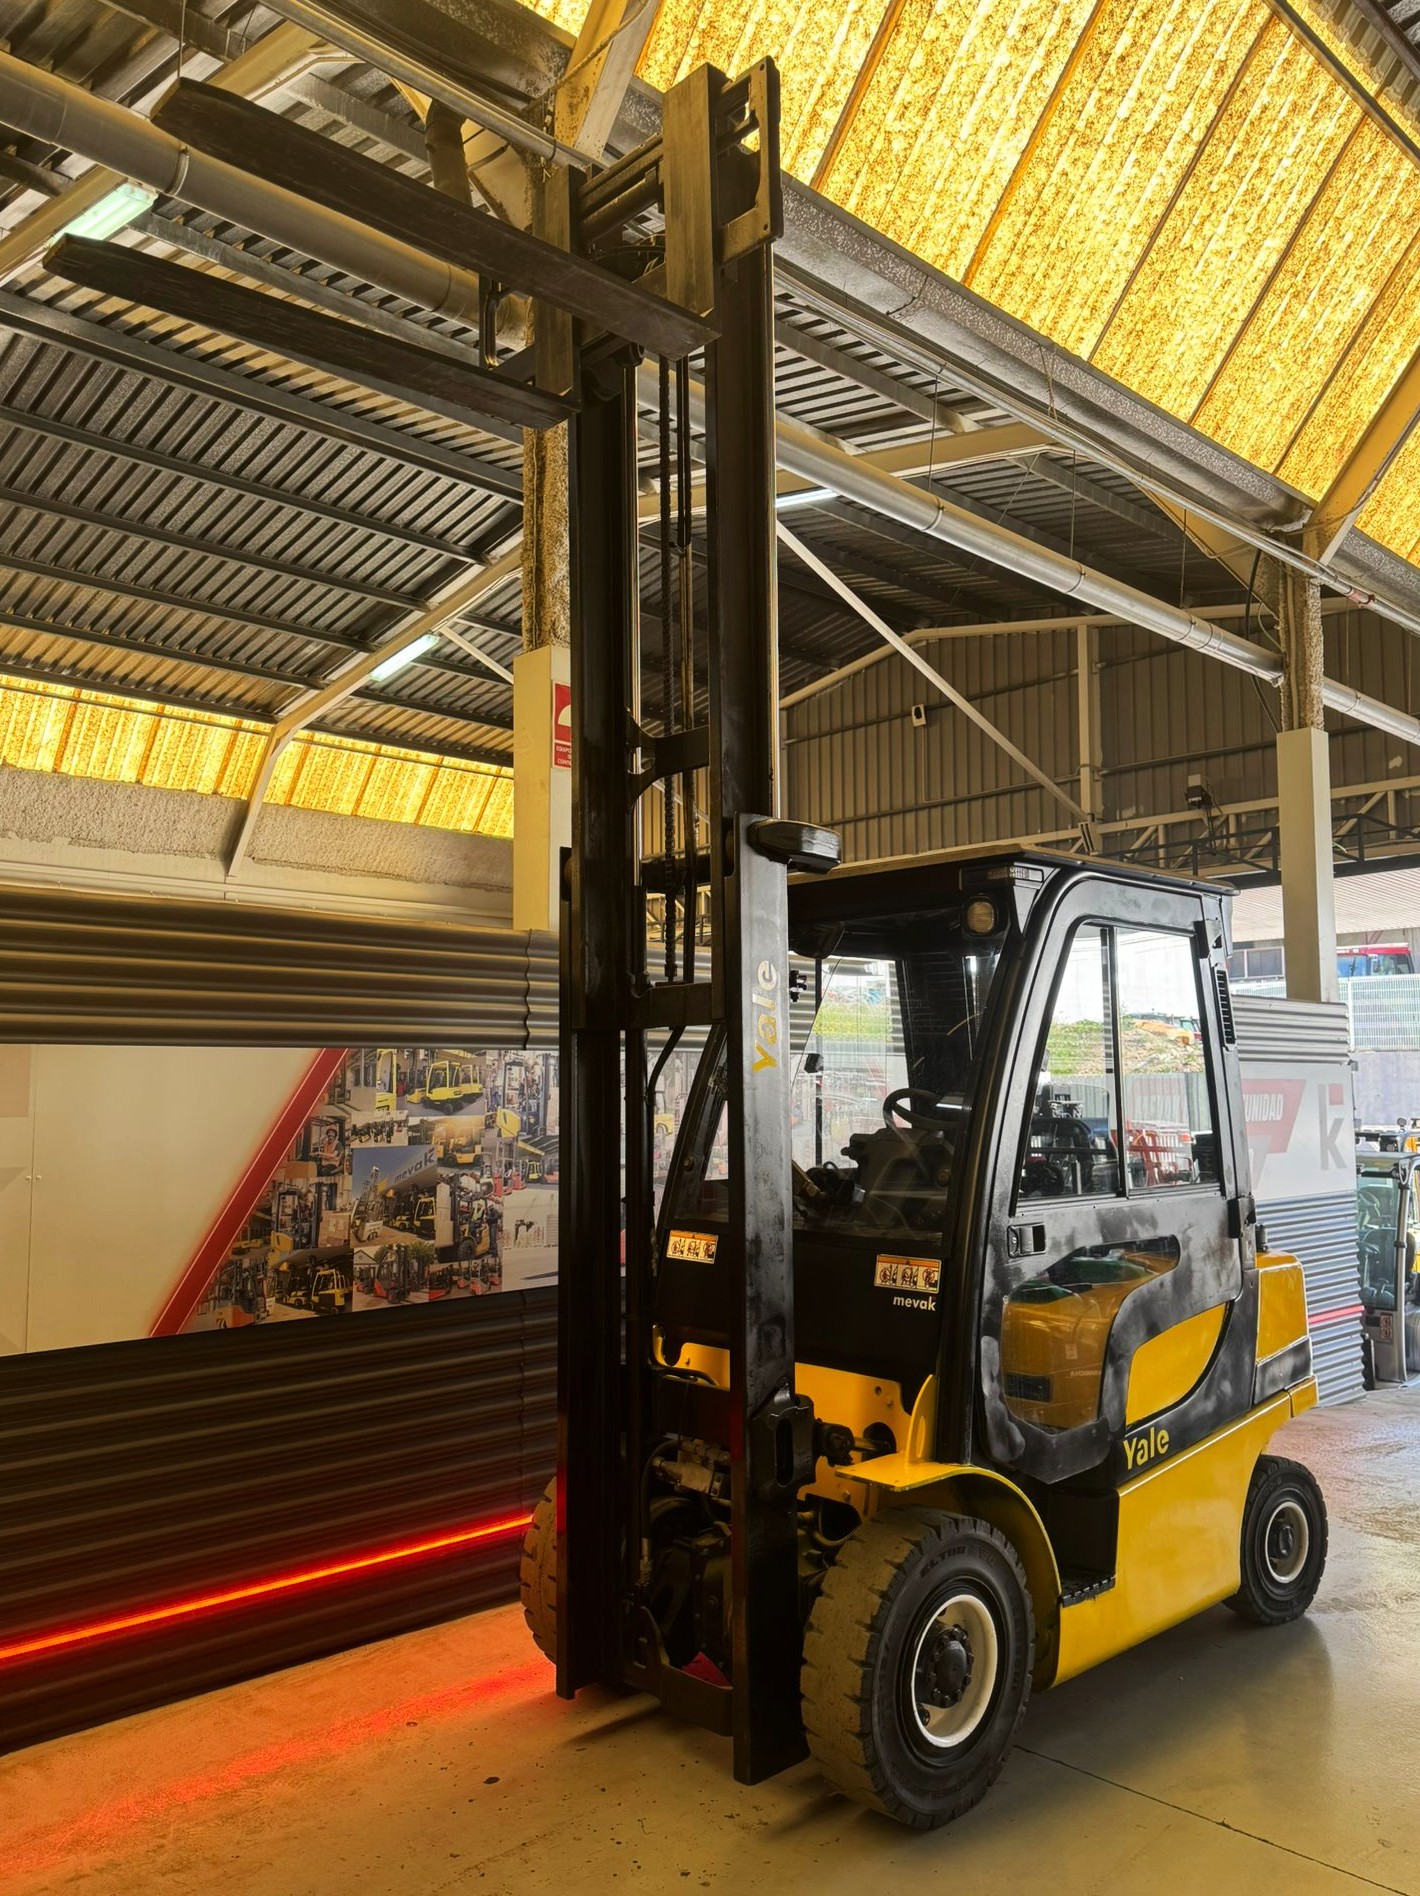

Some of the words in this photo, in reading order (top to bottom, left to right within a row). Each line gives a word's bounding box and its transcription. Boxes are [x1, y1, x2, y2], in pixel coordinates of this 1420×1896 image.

[752, 959, 778, 1073] Yale
[1242, 1092, 1285, 1122] UNIDAD
[892, 1295, 937, 1312] mevak
[1122, 1425, 1170, 1471] Yale
